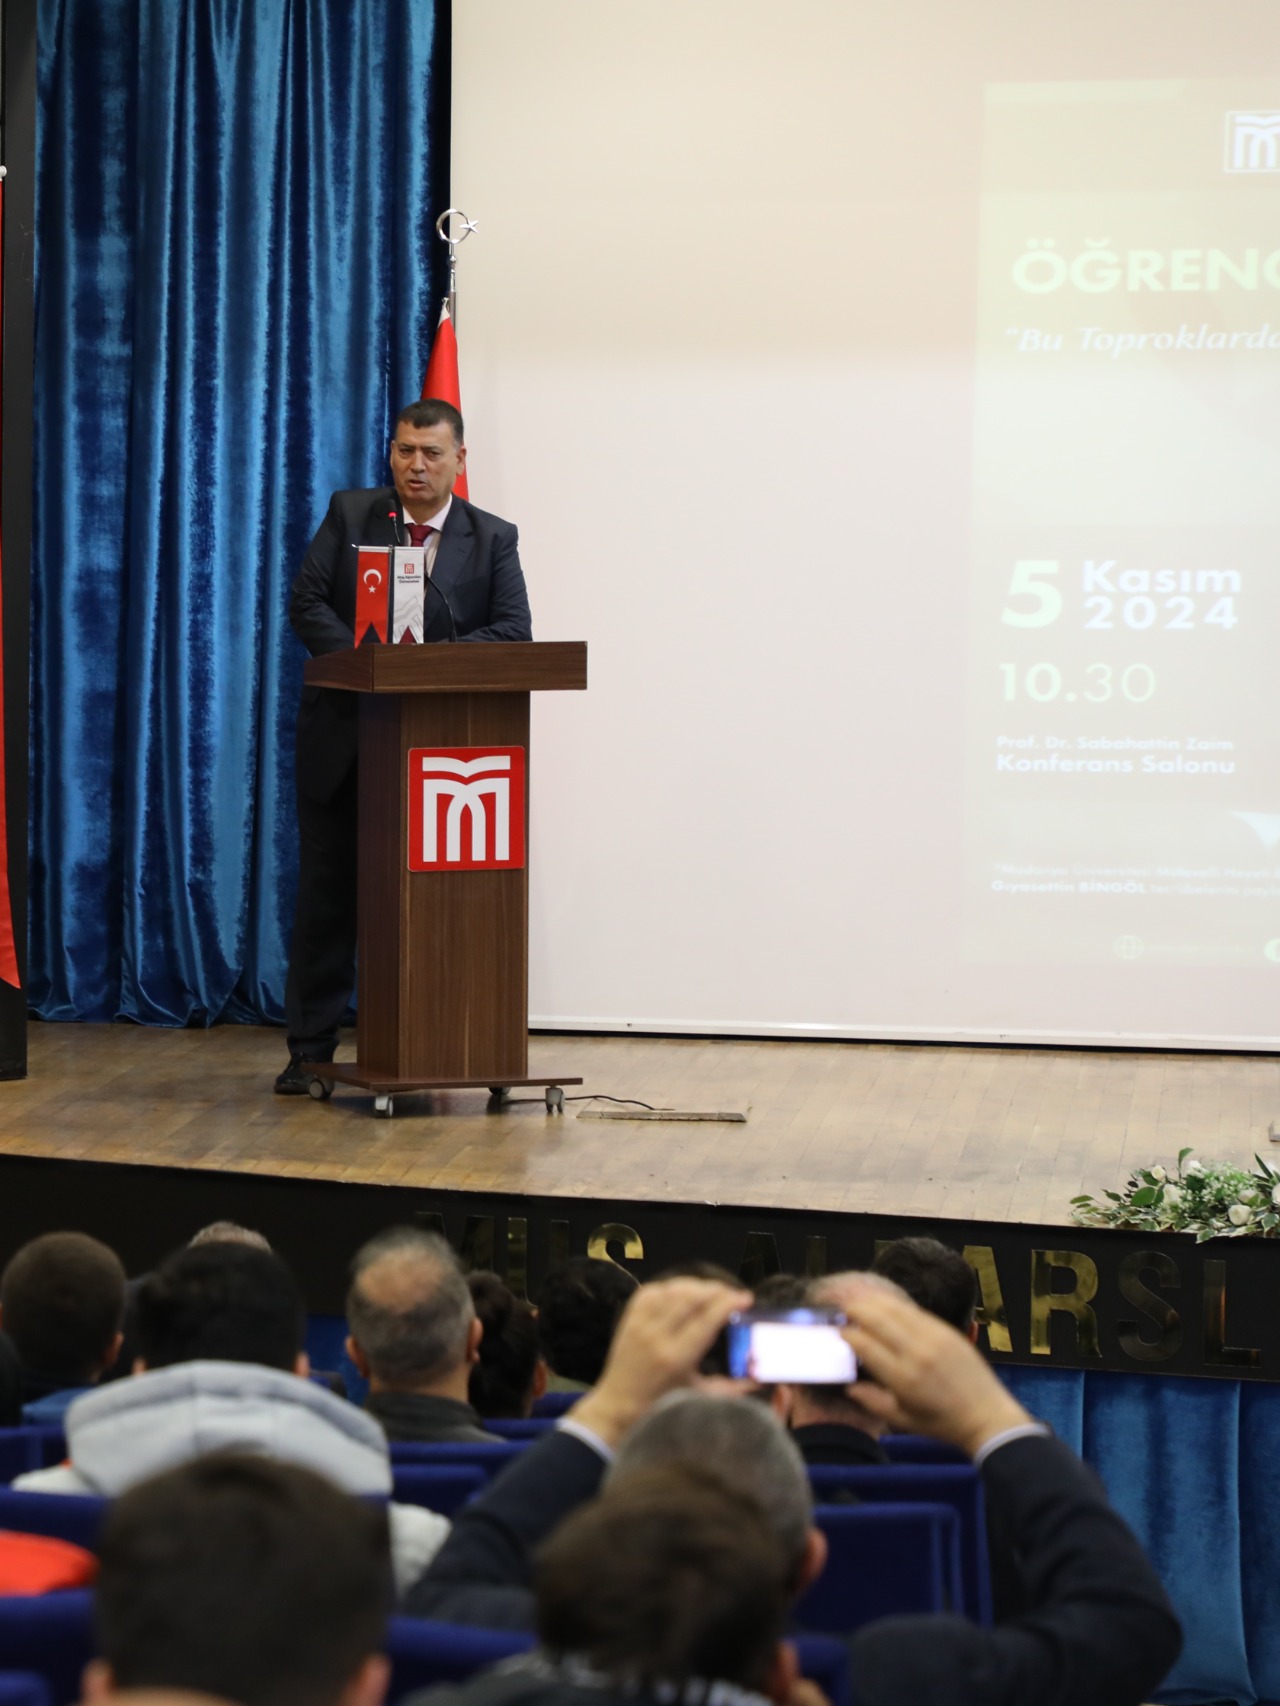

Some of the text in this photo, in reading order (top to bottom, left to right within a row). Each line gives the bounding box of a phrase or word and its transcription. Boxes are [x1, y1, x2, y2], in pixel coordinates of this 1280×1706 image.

[1081, 560, 1242, 593] Kasım
[1000, 560, 1063, 628] 5
[1082, 595, 1238, 630] 2024
[998, 662, 1156, 703] 10.30
[995, 735, 1040, 750] Prof.
[1045, 736, 1071, 750] Dr.
[1186, 737, 1233, 751] Zaim
[995, 753, 1236, 775] Konferans Salonu
